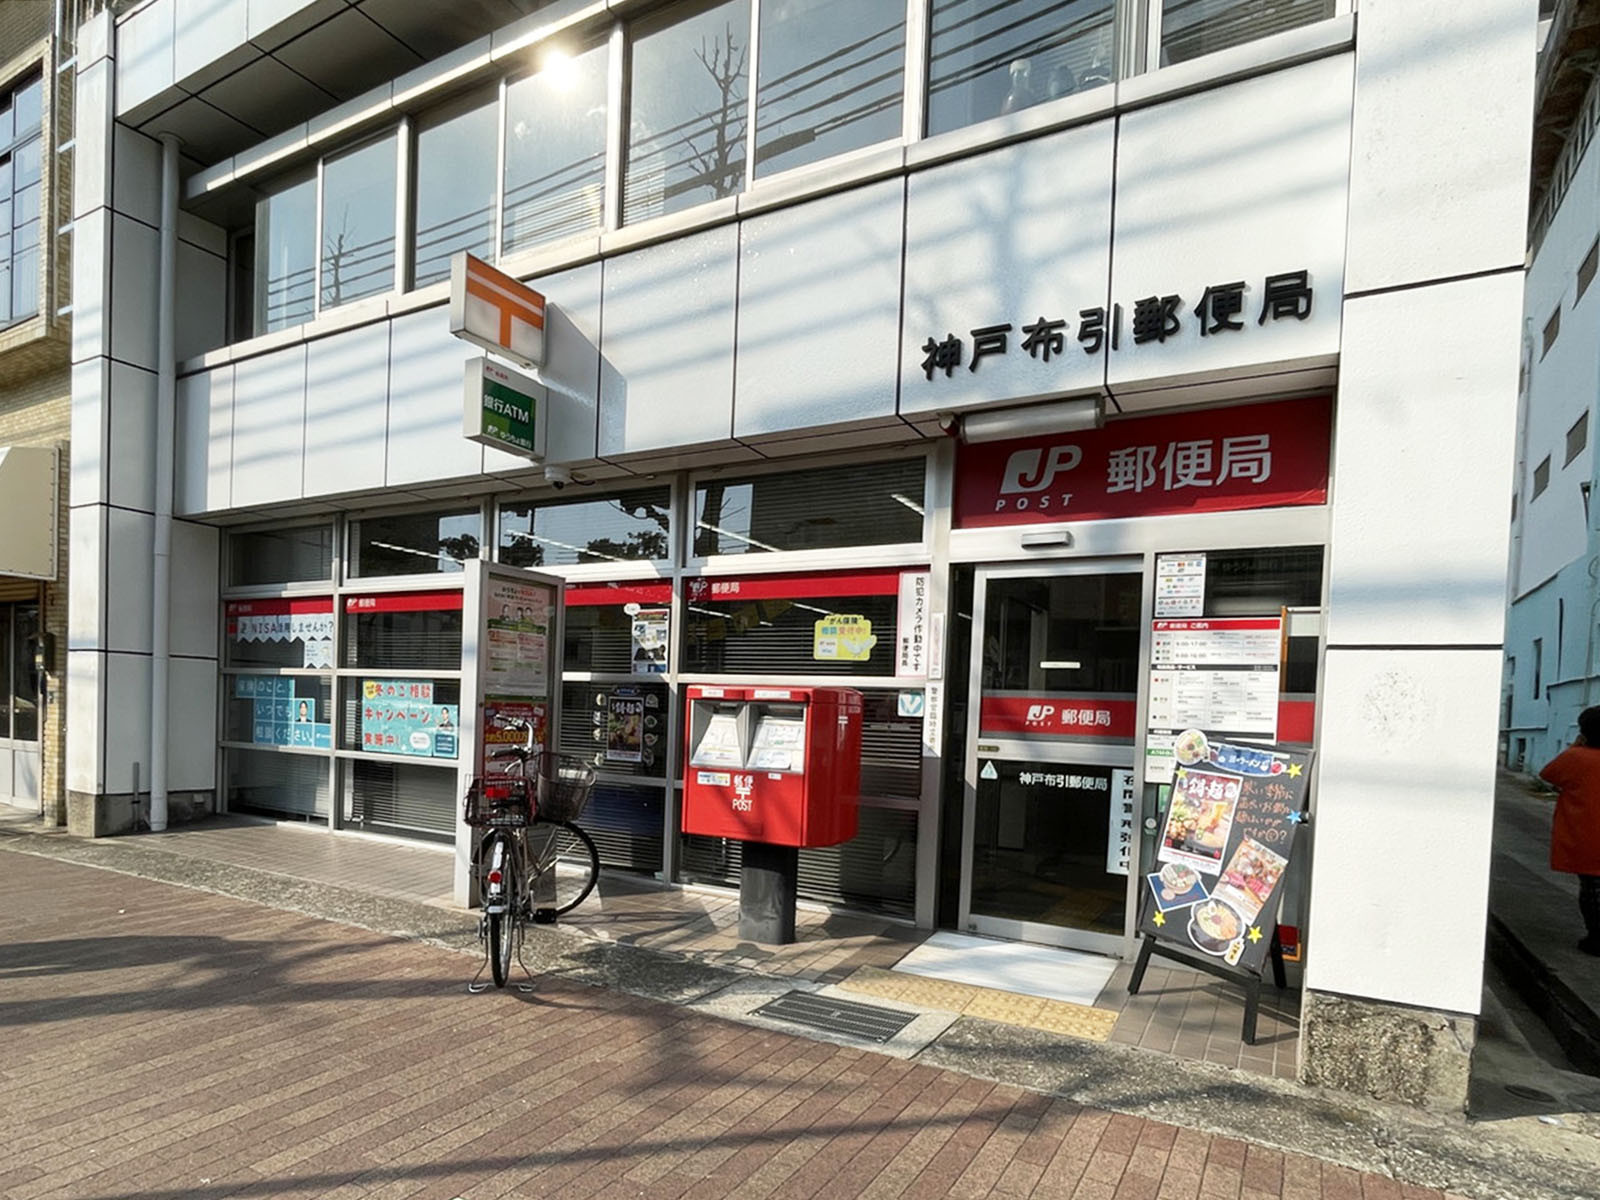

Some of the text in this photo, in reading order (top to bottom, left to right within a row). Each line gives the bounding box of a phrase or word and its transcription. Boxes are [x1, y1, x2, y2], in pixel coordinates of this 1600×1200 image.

[921, 269, 1312, 381] 神戸布引郵便局
[484, 394, 529, 423] 銀行ATM
[999, 434, 1273, 494] JP 郵便局
[995, 494, 1074, 511] POST
[364, 707, 430, 724] キャンペーン
[1061, 709, 1111, 727] 郵便局
[733, 775, 754, 790] 郵便
[1019, 771, 1108, 791] 神戸布引郵便局
[732, 799, 753, 812] POST
